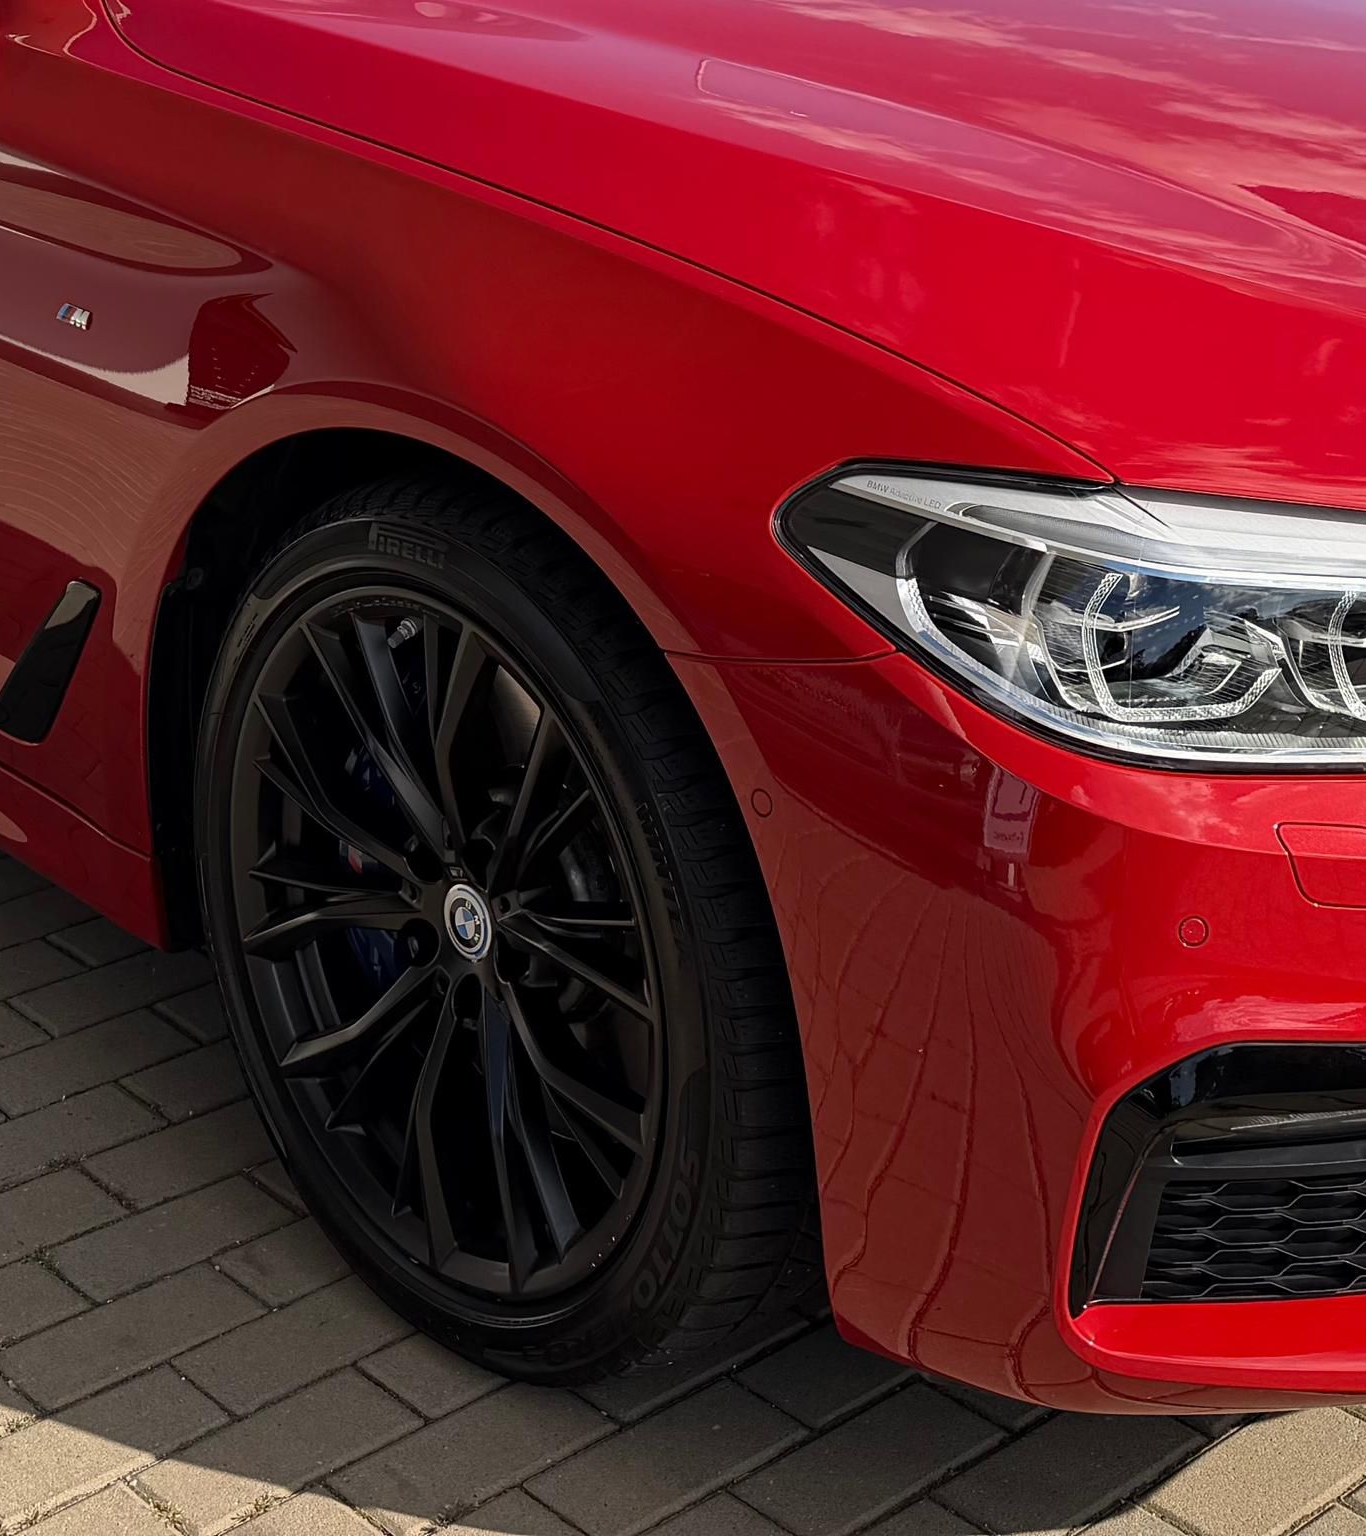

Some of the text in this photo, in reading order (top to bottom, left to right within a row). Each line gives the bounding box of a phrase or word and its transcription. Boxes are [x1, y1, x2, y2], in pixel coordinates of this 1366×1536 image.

[866, 479, 890, 493] BMW
[923, 496, 942, 510] LED
[367, 520, 450, 569] PIRELLI
